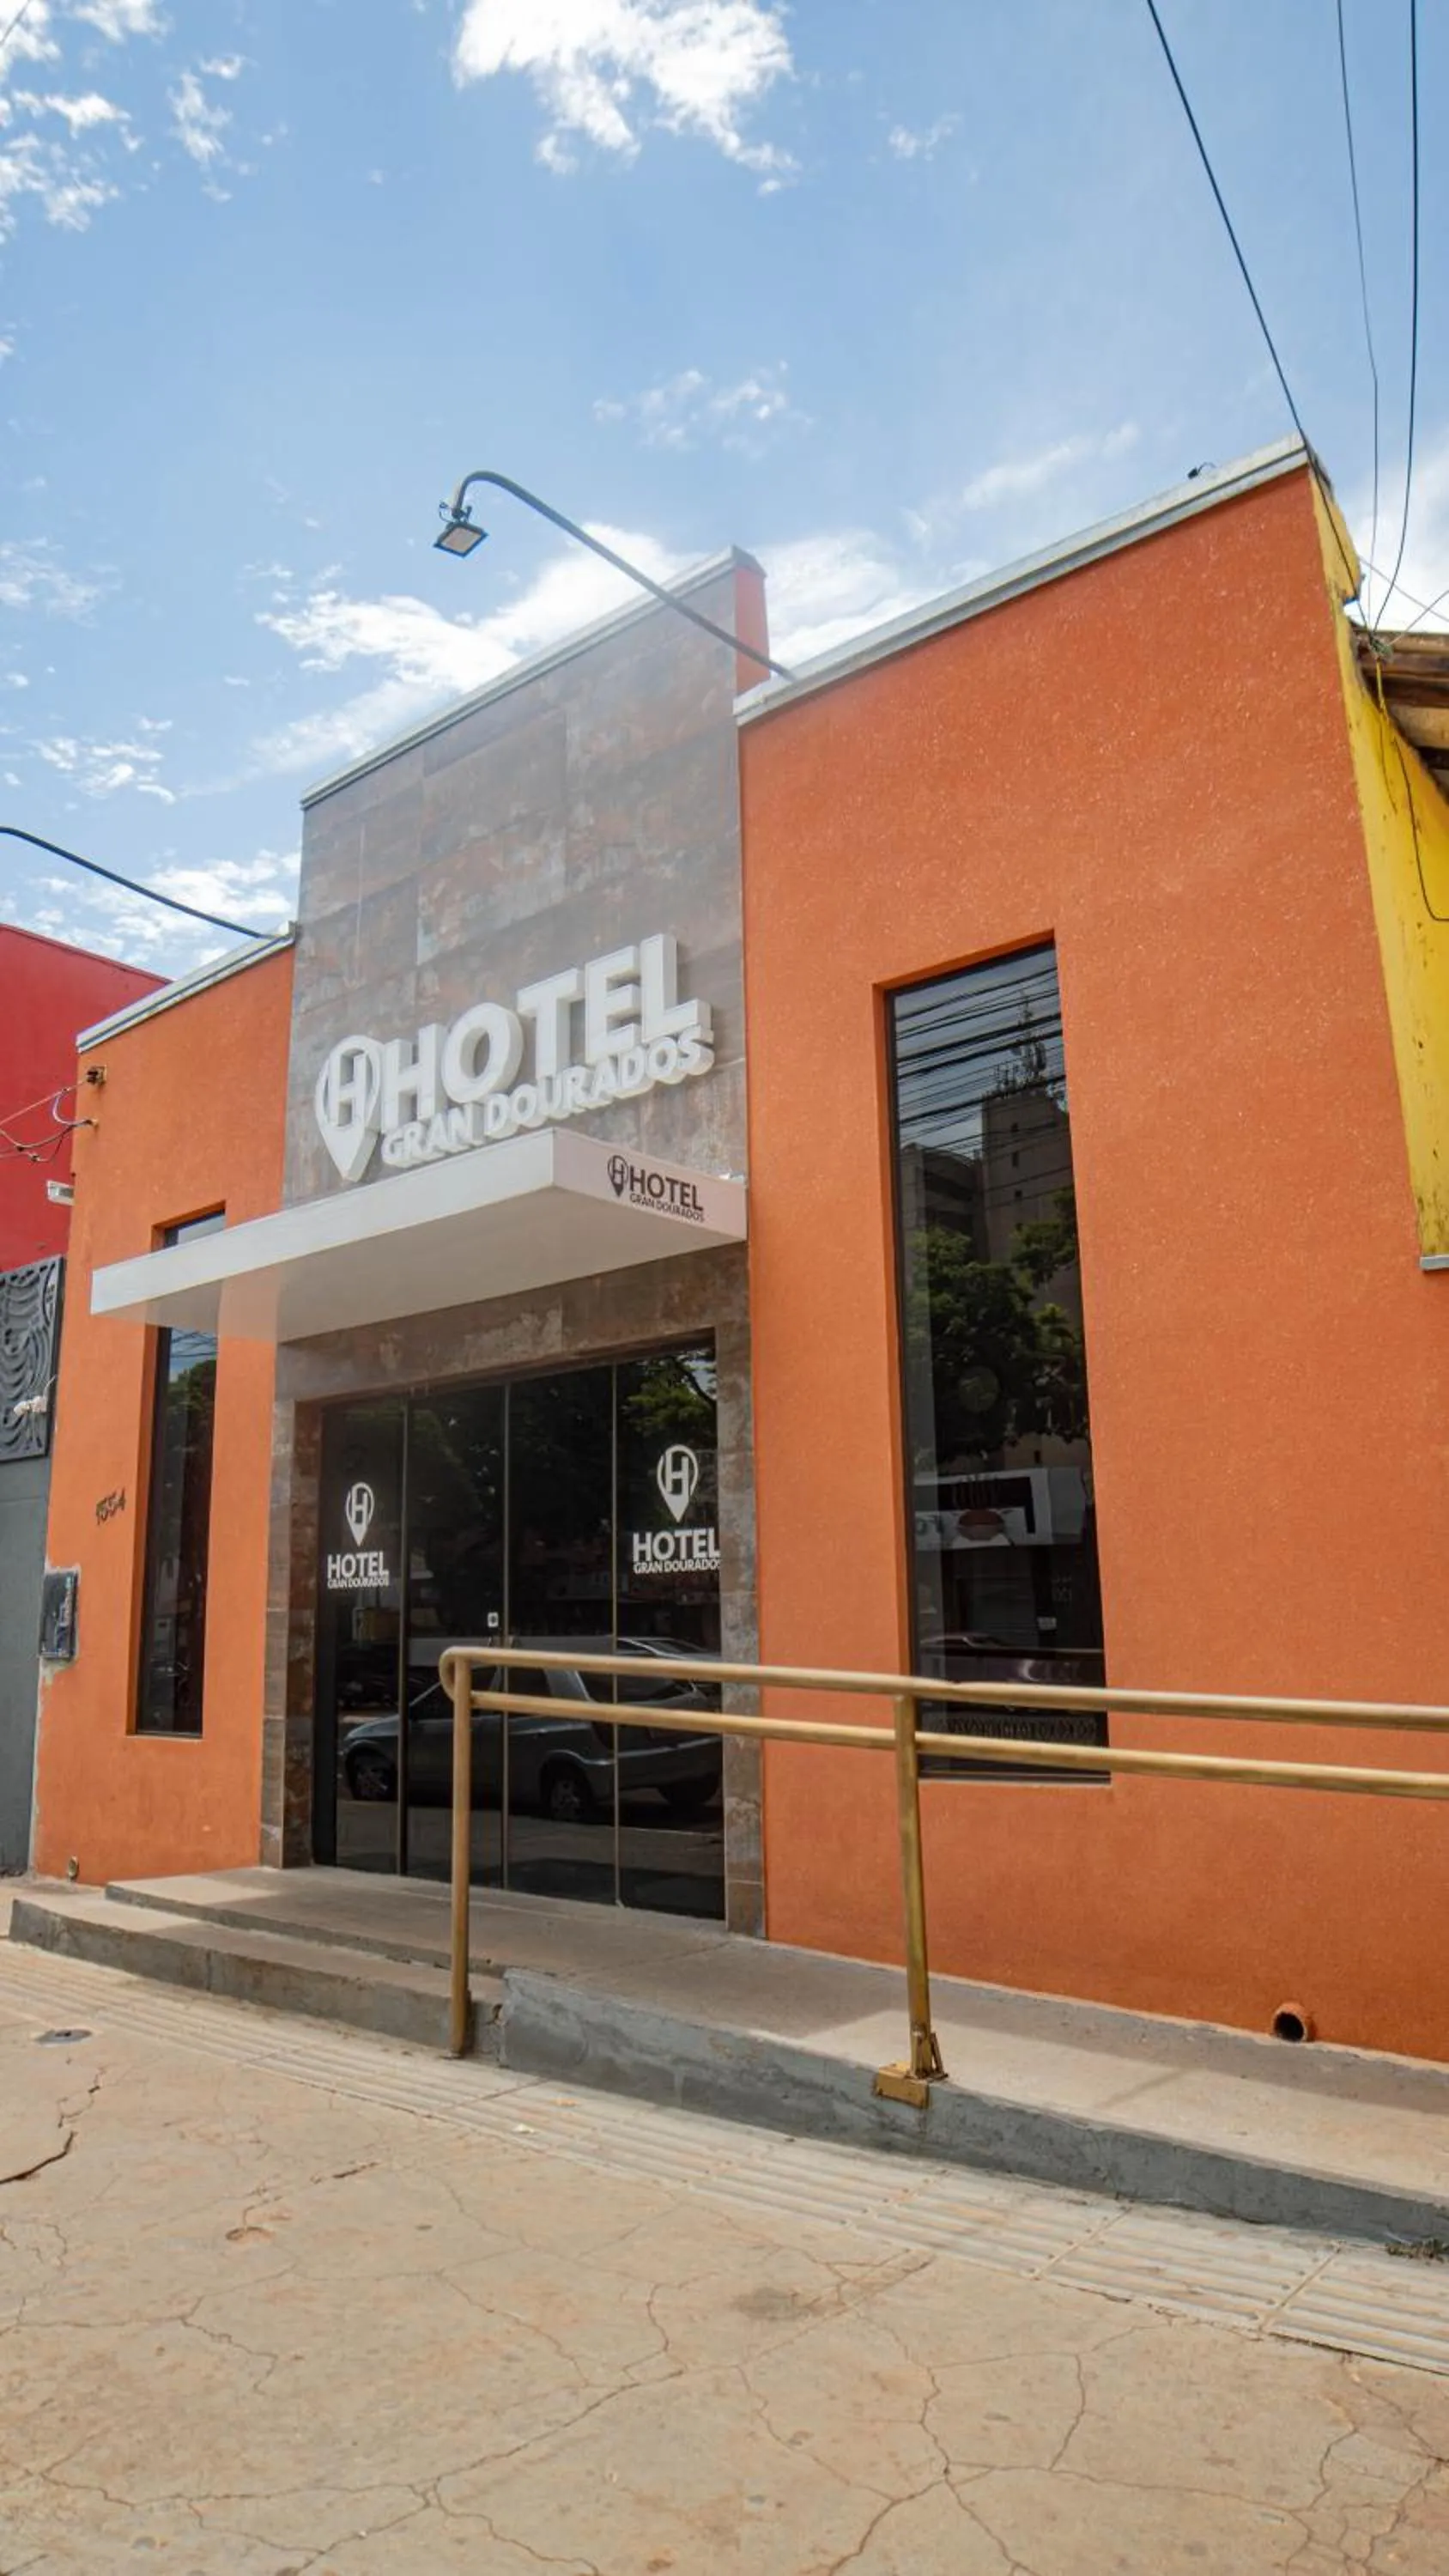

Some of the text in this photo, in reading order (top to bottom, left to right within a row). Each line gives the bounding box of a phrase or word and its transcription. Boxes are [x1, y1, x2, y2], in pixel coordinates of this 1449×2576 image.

[381, 933, 712, 1135] HOTEL
[381, 1024, 715, 1168] GRAN DOURADOS
[629, 1164, 704, 1212] HOTEL
[629, 1192, 705, 1223] GRAN DOURADOS
[633, 1528, 720, 1562] HOTEL
[327, 1551, 390, 1579] HOTEL
[634, 1561, 664, 1574] GRAN
[327, 1577, 348, 1589] GRAN
